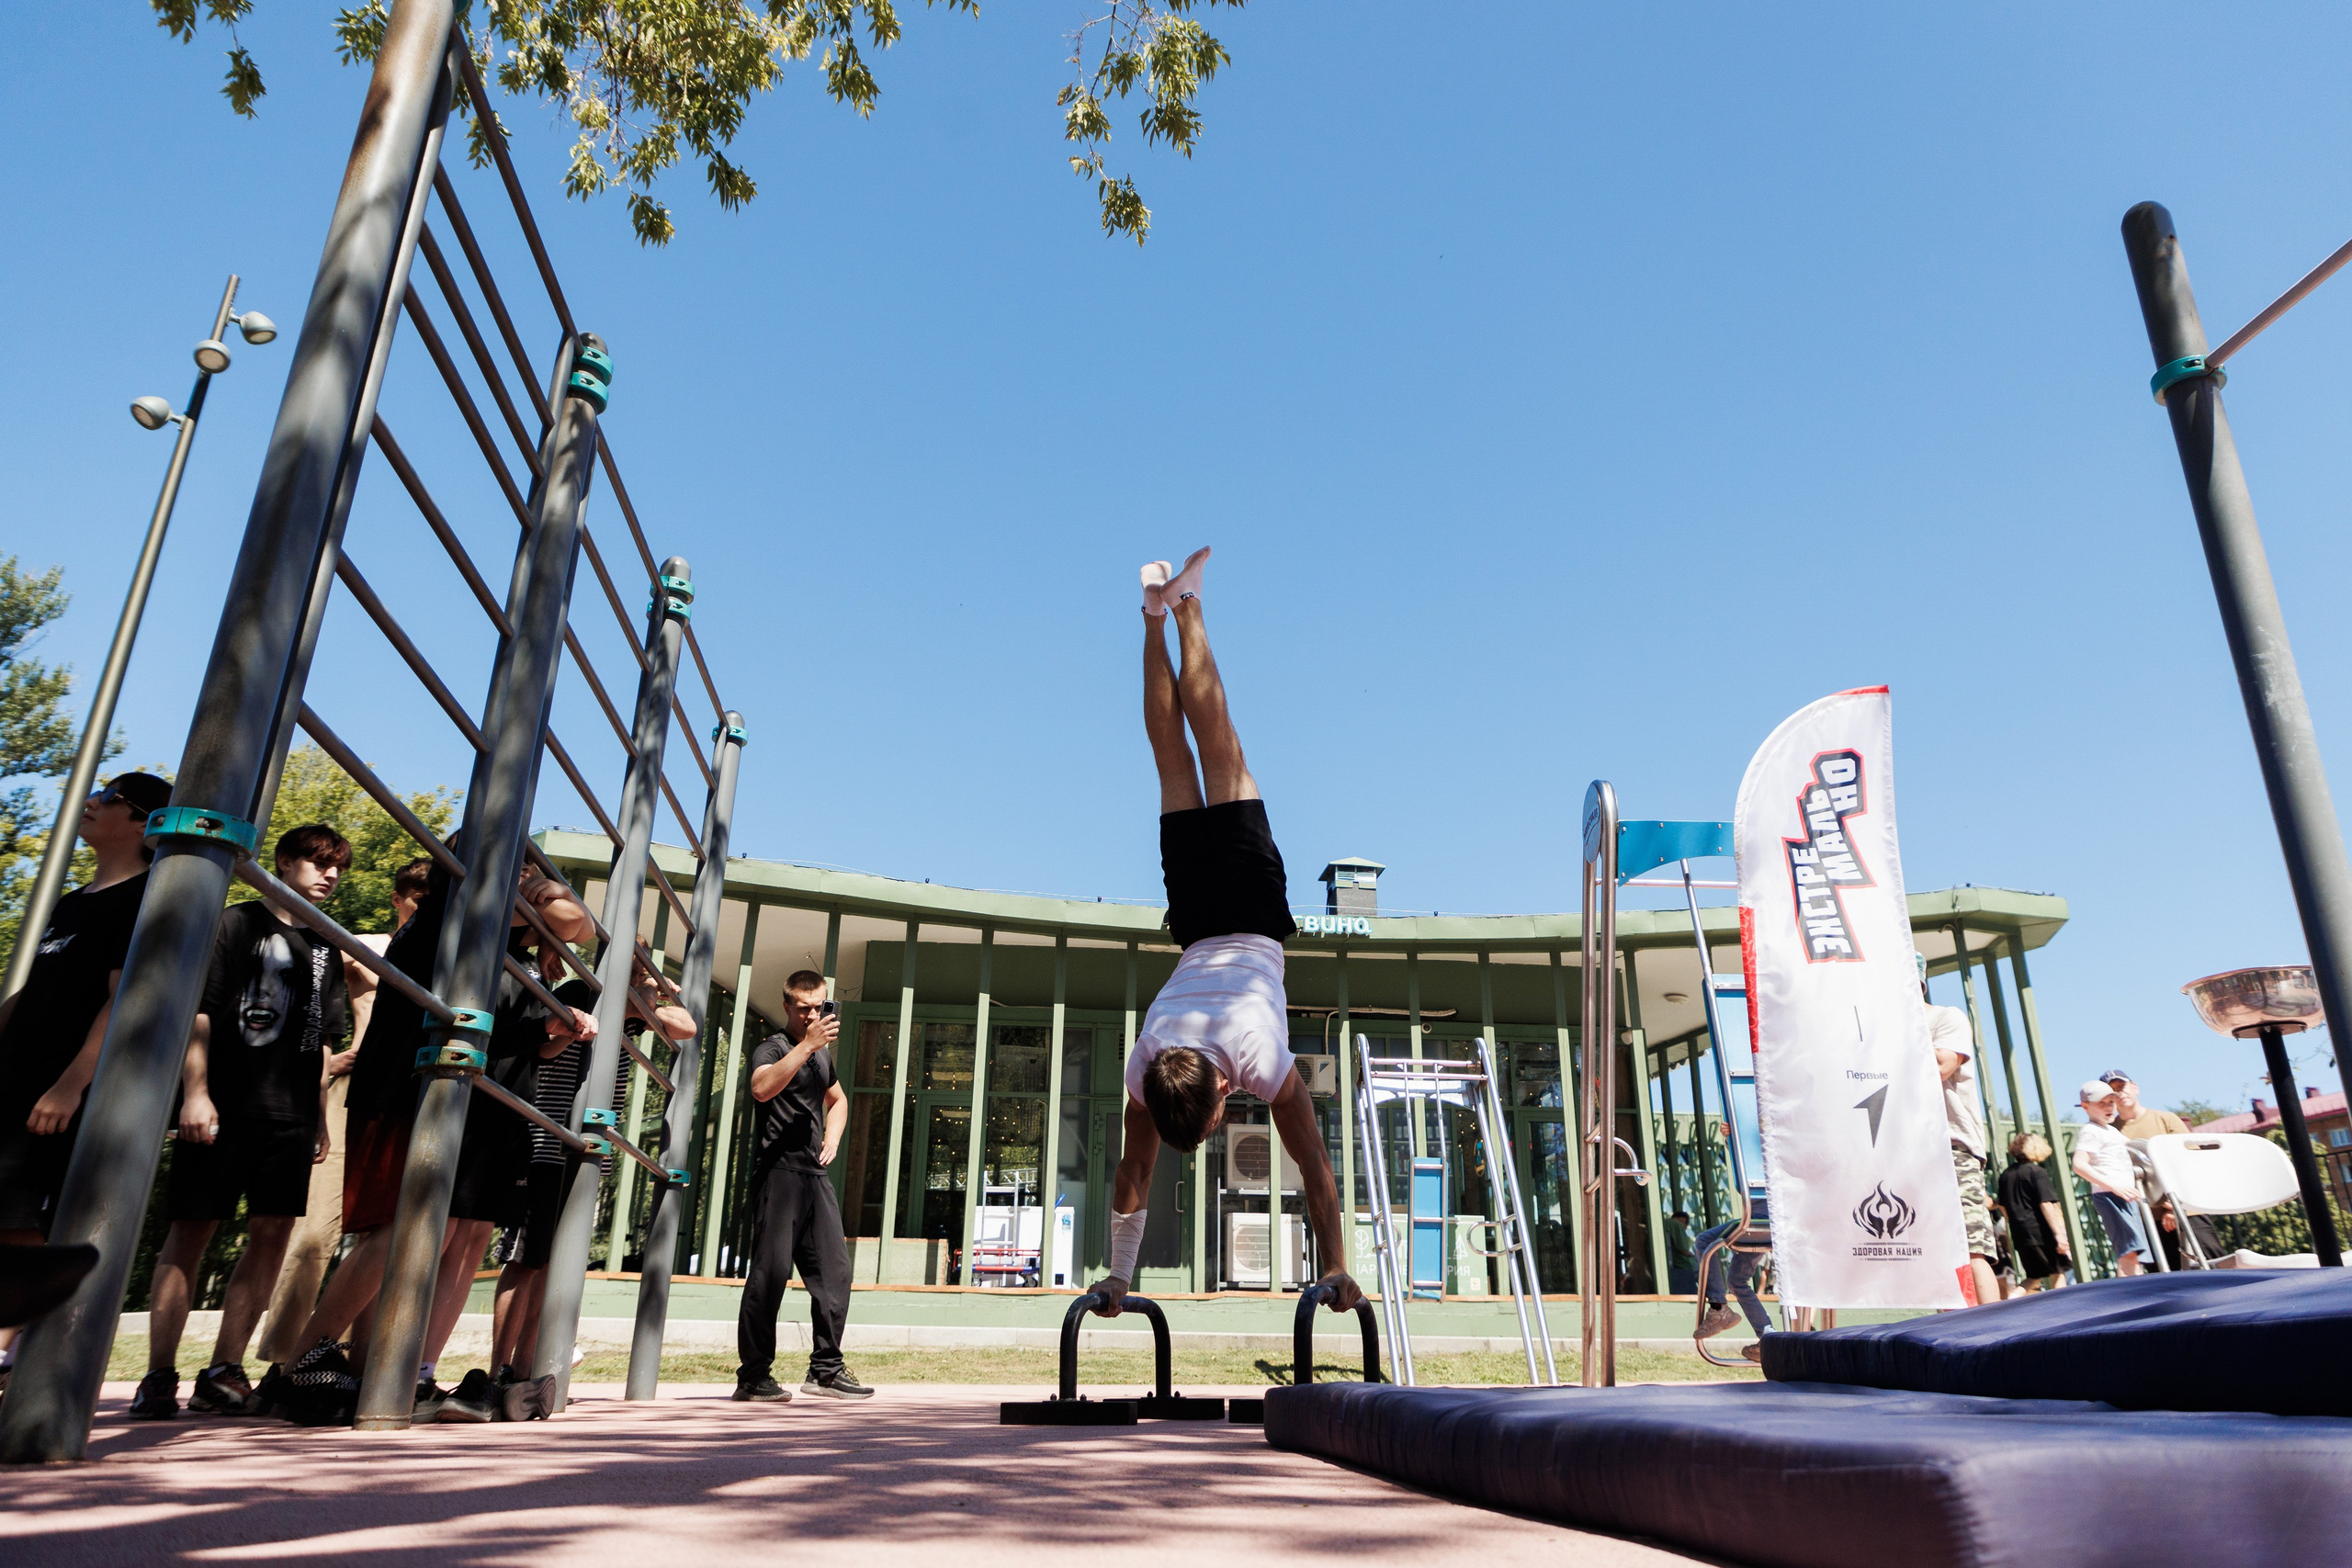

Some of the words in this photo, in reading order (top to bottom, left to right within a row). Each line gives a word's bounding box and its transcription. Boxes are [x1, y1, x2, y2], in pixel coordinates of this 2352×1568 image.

[1820, 758, 1859, 812] НО
[1806, 789, 1863, 880] МАЛЬ
[1792, 847, 1852, 953] ЭКСТРЕ
[1846, 1070, 1889, 1082] Первые
[1852, 1247, 1894, 1257] ЗДОРОВАЯ
[1895, 1247, 1923, 1257] НАЦИЯ
